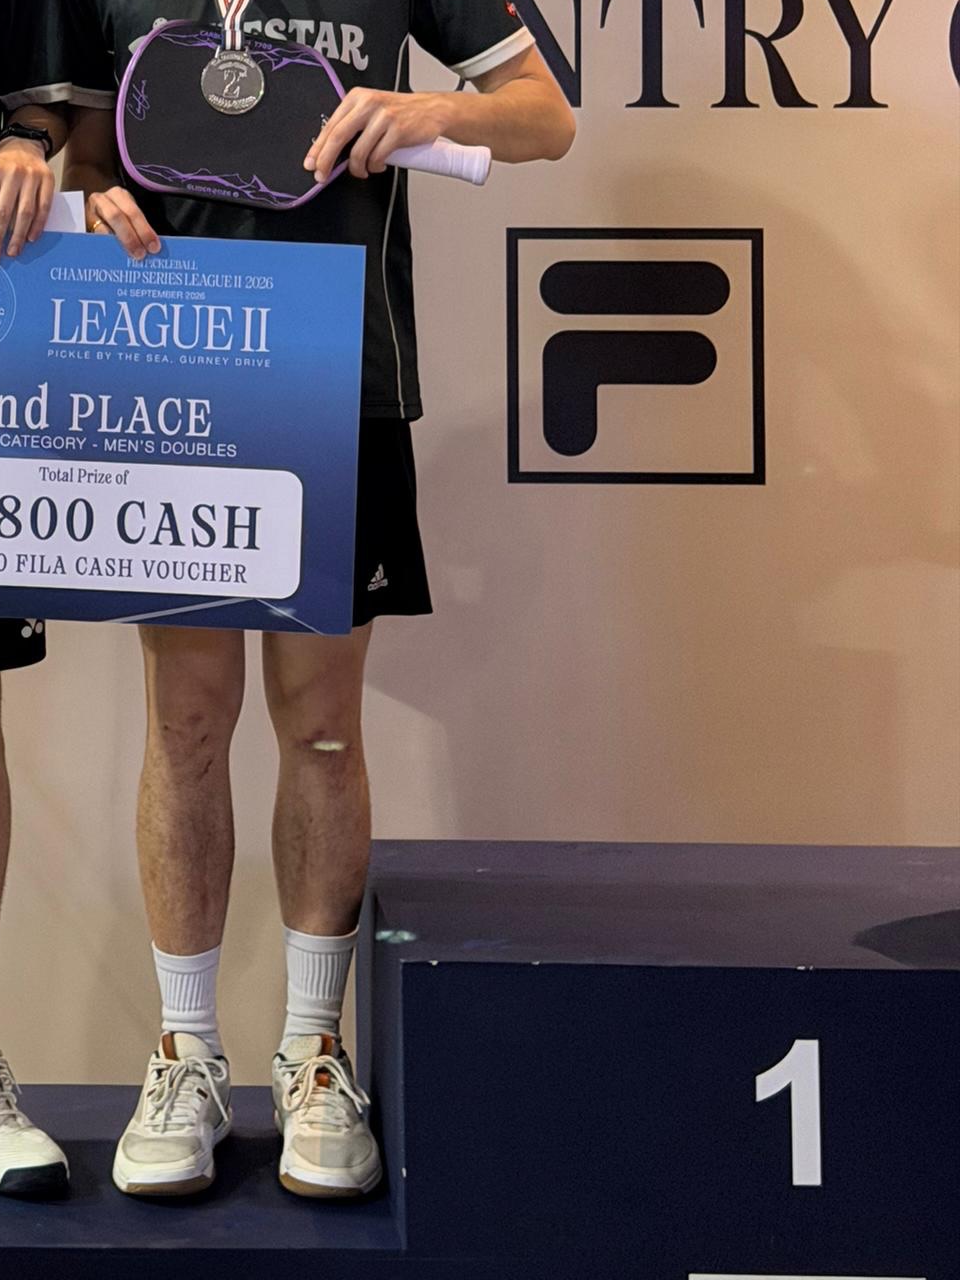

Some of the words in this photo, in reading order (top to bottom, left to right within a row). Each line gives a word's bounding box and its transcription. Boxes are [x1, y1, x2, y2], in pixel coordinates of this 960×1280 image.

[49, 267, 141, 285] CHAMPIONSHIP
[142, 270, 183, 286] SERIES
[184, 273, 234, 288] LEAGUE
[245, 276, 274, 290] 2026
[130, 288, 184, 299] SEPTEMBER
[49, 297, 234, 351] LEAGUE
[240, 306, 272, 353] II
[47, 349, 91, 360] PICKLE
[96, 351, 112, 361] BY
[118, 353, 140, 362] THE
[179, 355, 230, 367] GURNEY
[235, 358, 272, 369] DRIVE
[68, 392, 212, 438] PLACE
[0, 433, 87, 451] CATEGORY
[161, 440, 238, 458] DOUBLES
[38, 466, 74, 484] Total
[76, 467, 113, 485] Prize
[114, 469, 131, 486] of
[116, 500, 262, 551] CASH
[16, 553, 68, 576] FILA
[75, 556, 134, 578] CASH
[141, 558, 248, 585] VOUCHER
[756, 1039, 822, 1186] 1
